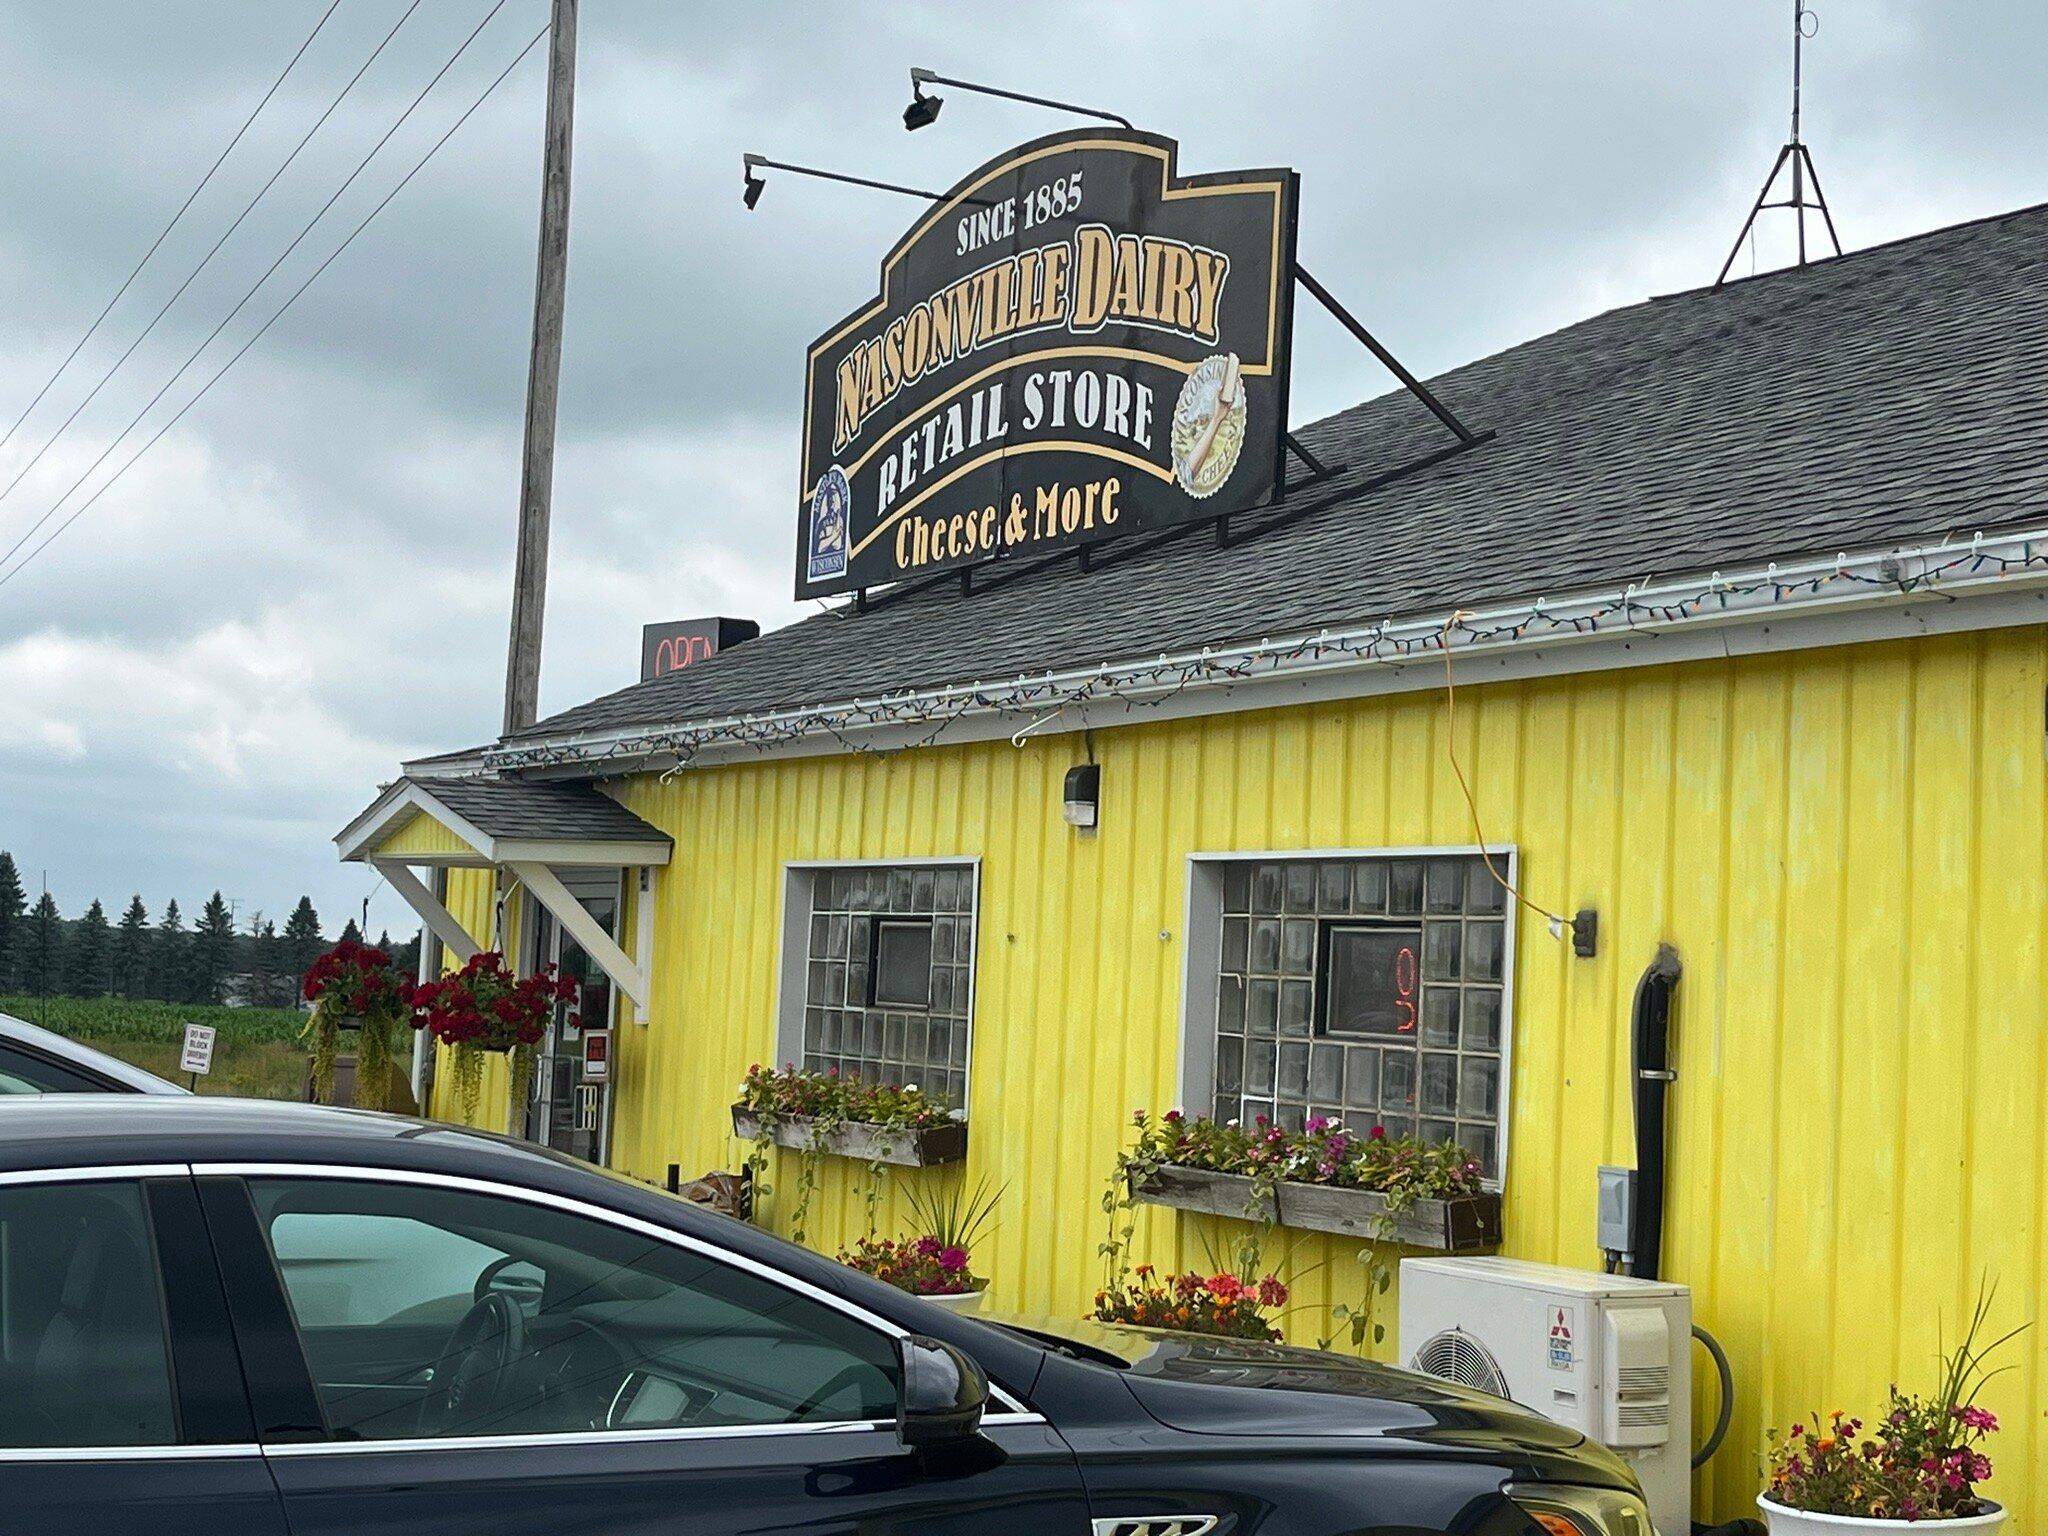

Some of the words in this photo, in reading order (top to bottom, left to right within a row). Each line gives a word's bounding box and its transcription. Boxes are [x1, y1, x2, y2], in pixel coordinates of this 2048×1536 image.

[957, 197, 1016, 256] SINCE
[1023, 170, 1083, 230] 1885
[834, 243, 1070, 452] NASONVILLE
[1071, 226, 1228, 342] DAIRY
[877, 383, 1008, 516] RETAIL
[1022, 370, 1153, 451] STORE
[1175, 362, 1225, 446] WISCONSIN
[895, 505, 997, 569] Cheese
[1004, 493, 1028, 547] &
[1033, 477, 1121, 540] More
